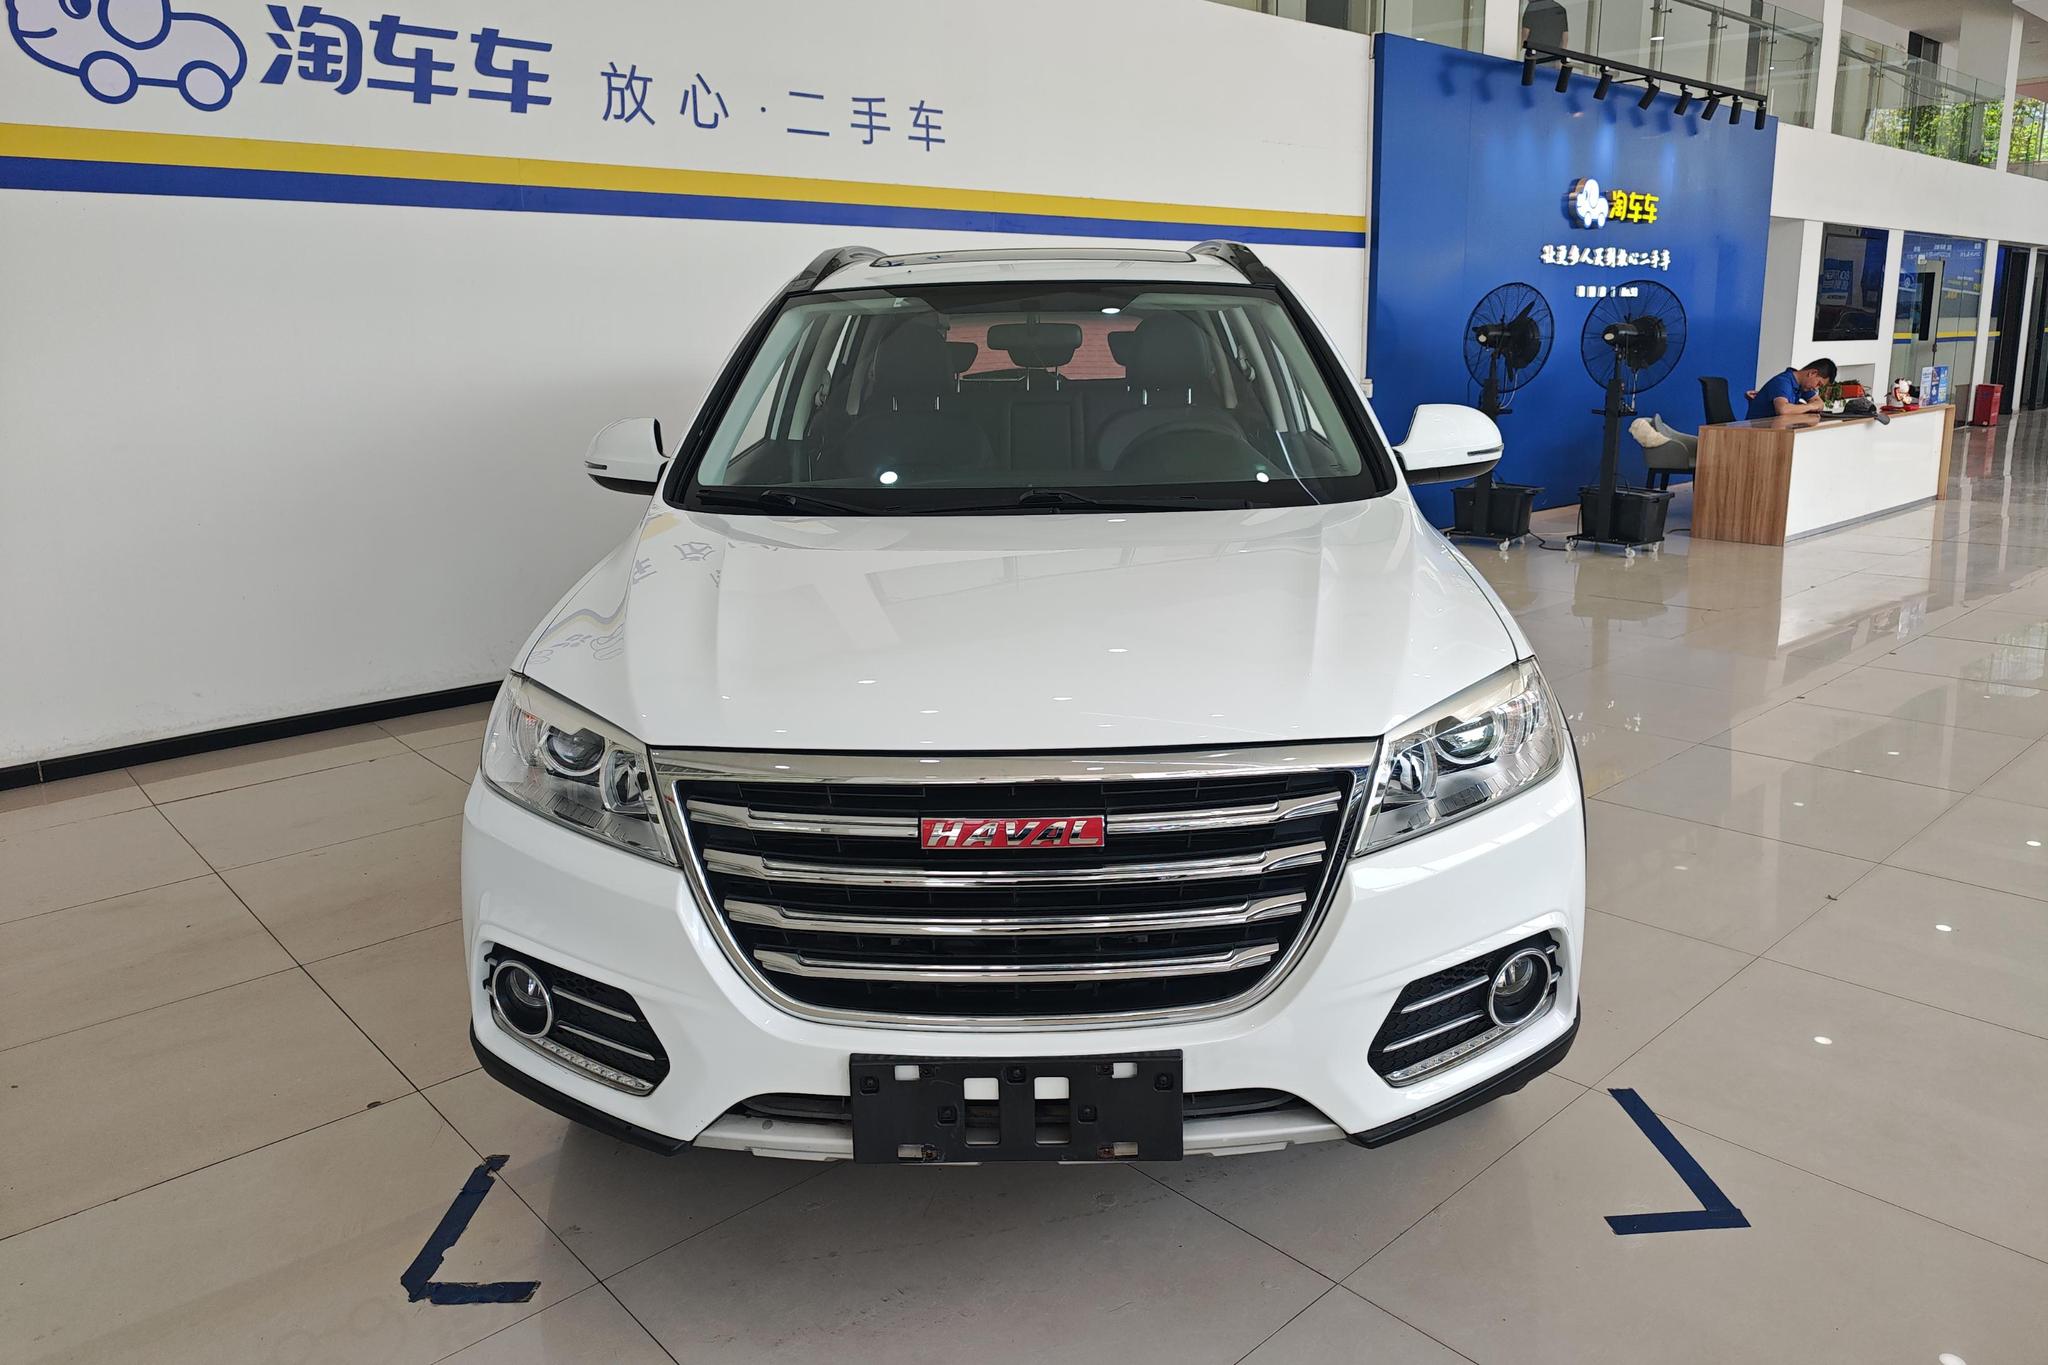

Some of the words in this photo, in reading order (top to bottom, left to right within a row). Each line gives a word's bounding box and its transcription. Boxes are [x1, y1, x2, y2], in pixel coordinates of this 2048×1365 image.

[260, 4, 552, 114] 淘车车
[1609, 190, 1659, 223] 淘车车
[927, 820, 1099, 847] HAVAL
